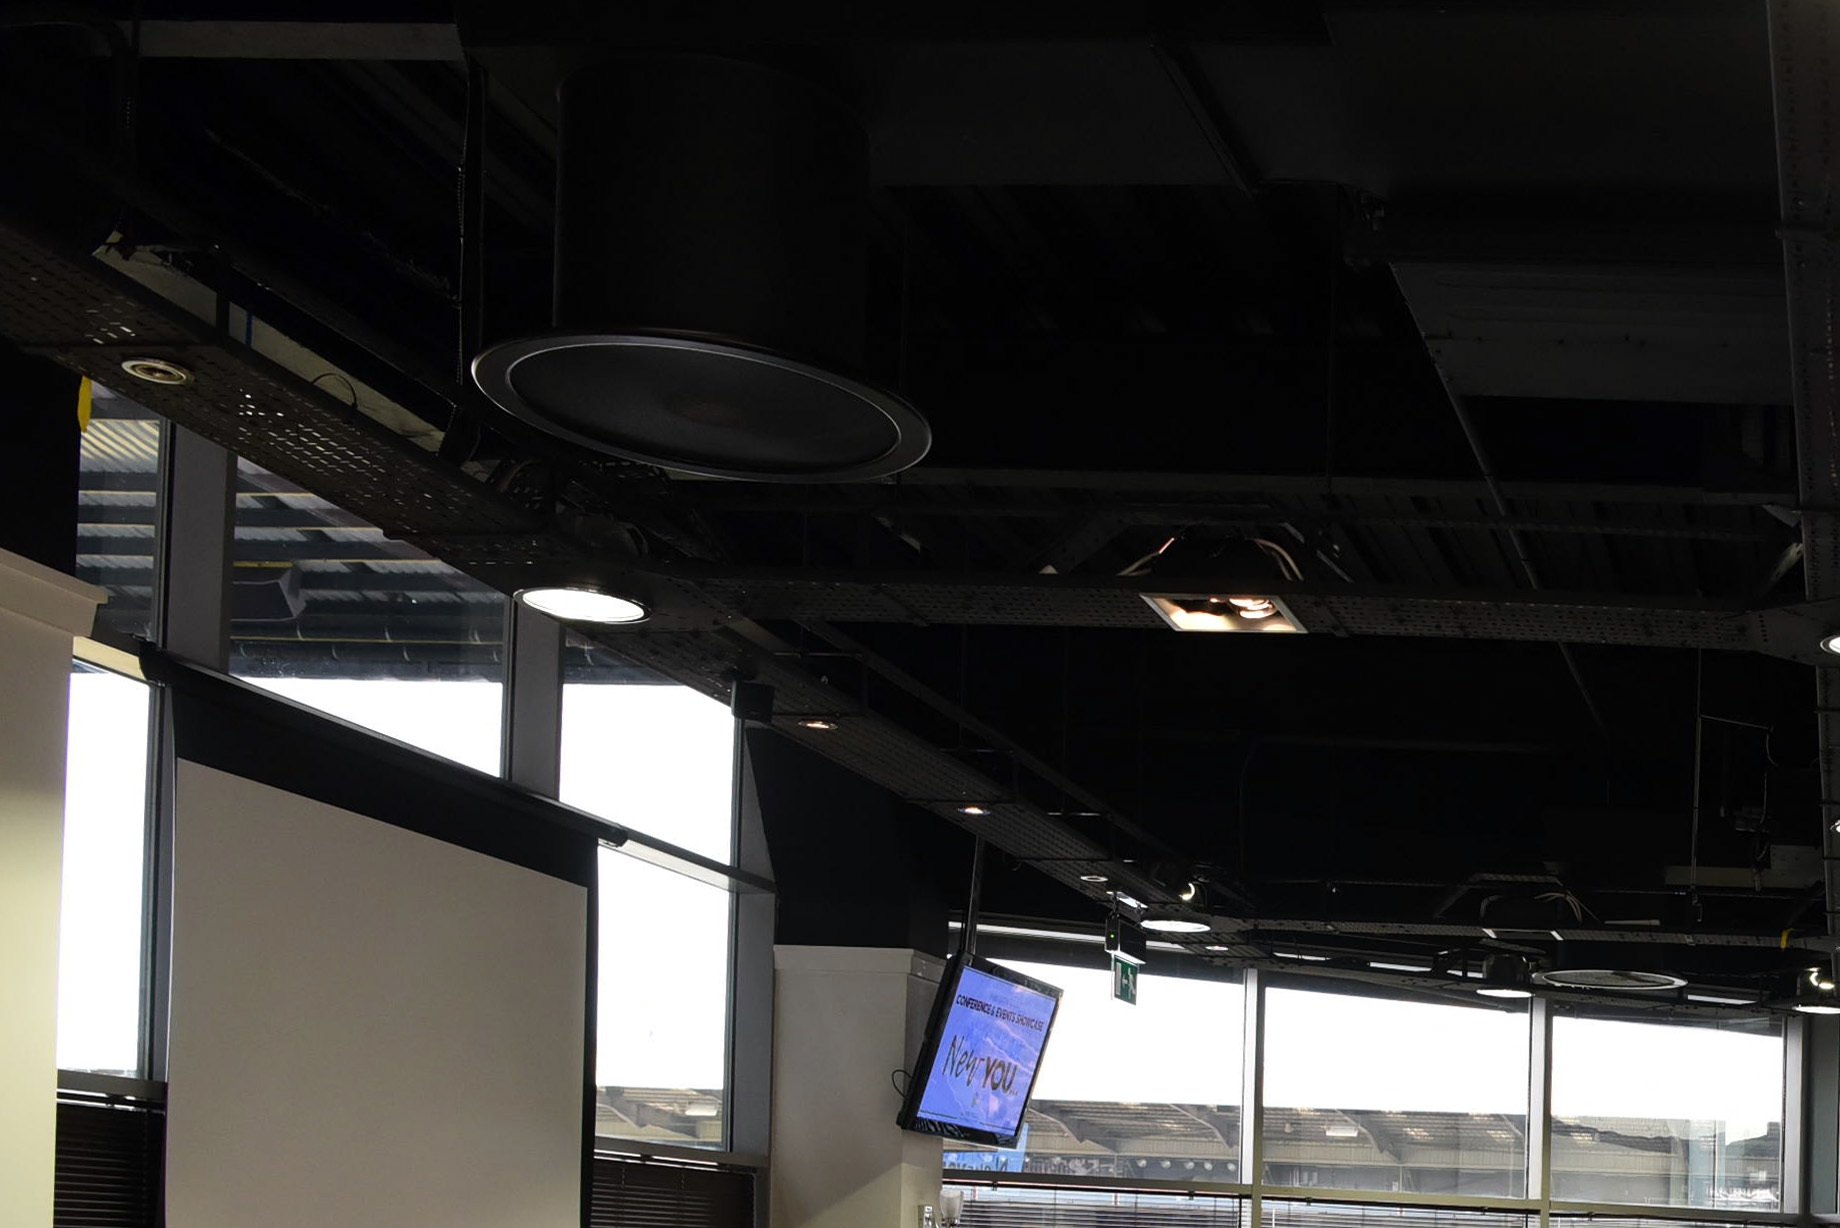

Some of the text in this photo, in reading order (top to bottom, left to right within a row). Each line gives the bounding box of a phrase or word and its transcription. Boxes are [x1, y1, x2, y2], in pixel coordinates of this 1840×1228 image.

[956, 994, 992, 1016] CONFERENCE
[995, 1007, 1017, 1023] EVENTS
[1015, 1014, 1044, 1032] SHOWCASE
[942, 1034, 985, 1088] New
